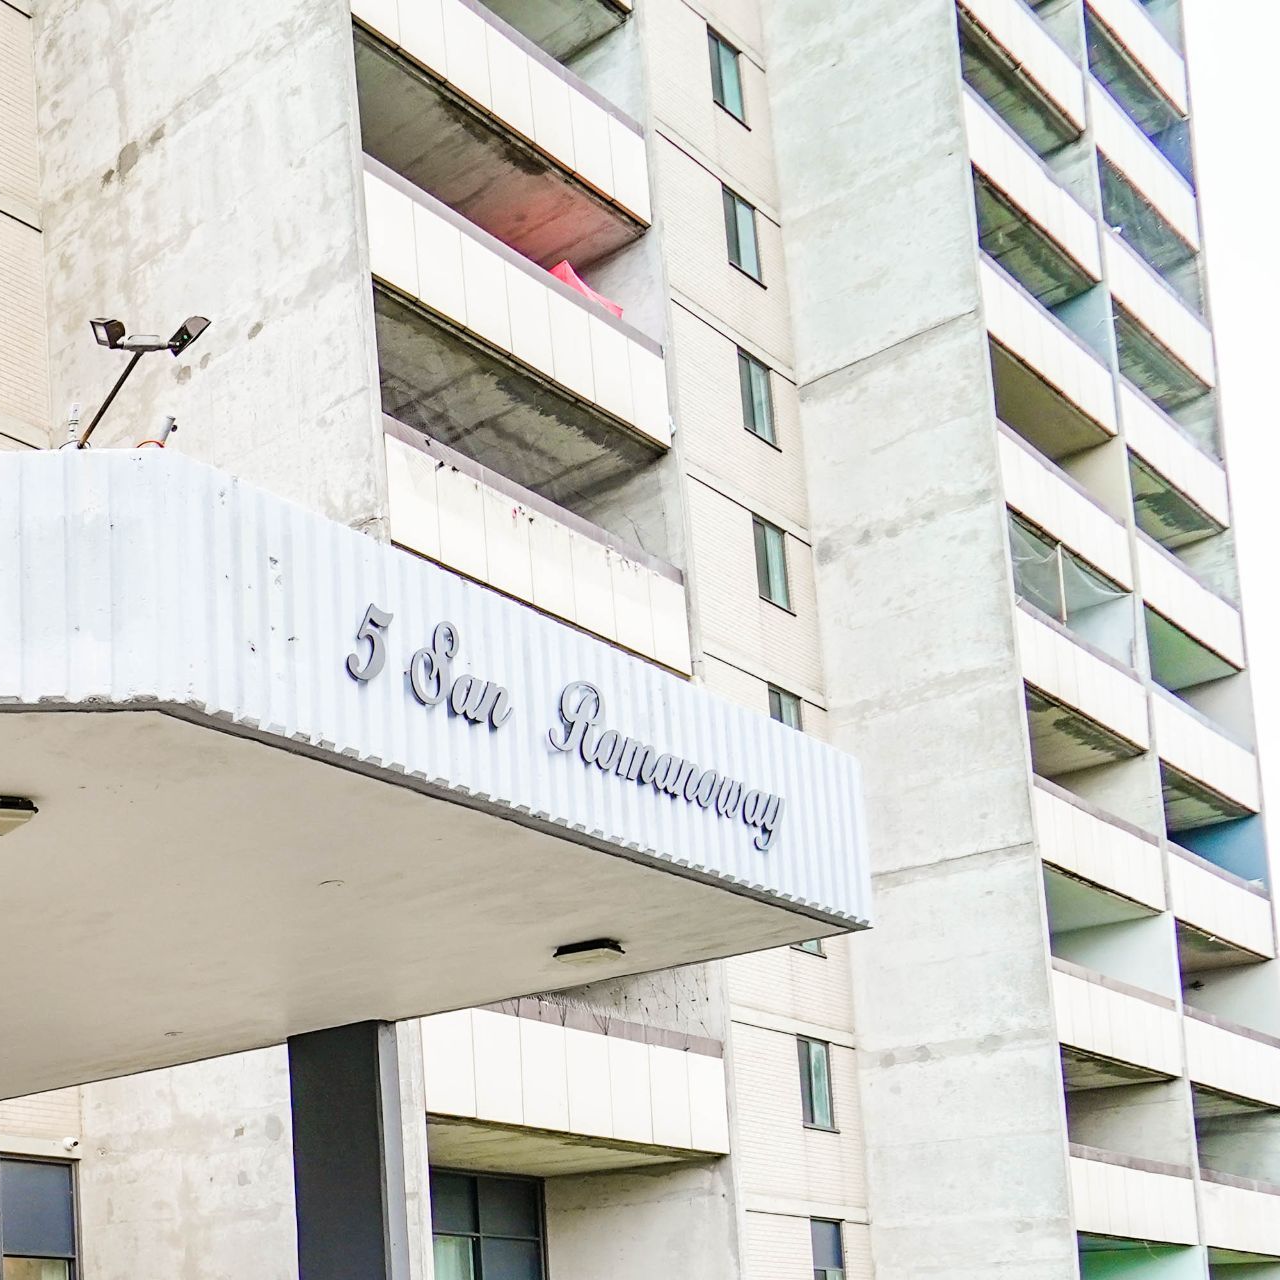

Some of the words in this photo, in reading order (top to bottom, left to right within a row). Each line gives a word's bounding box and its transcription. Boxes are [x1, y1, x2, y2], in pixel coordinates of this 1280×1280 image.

[346, 602, 394, 681] 5
[409, 620, 514, 729] San
[548, 680, 786, 851] Romanoway
